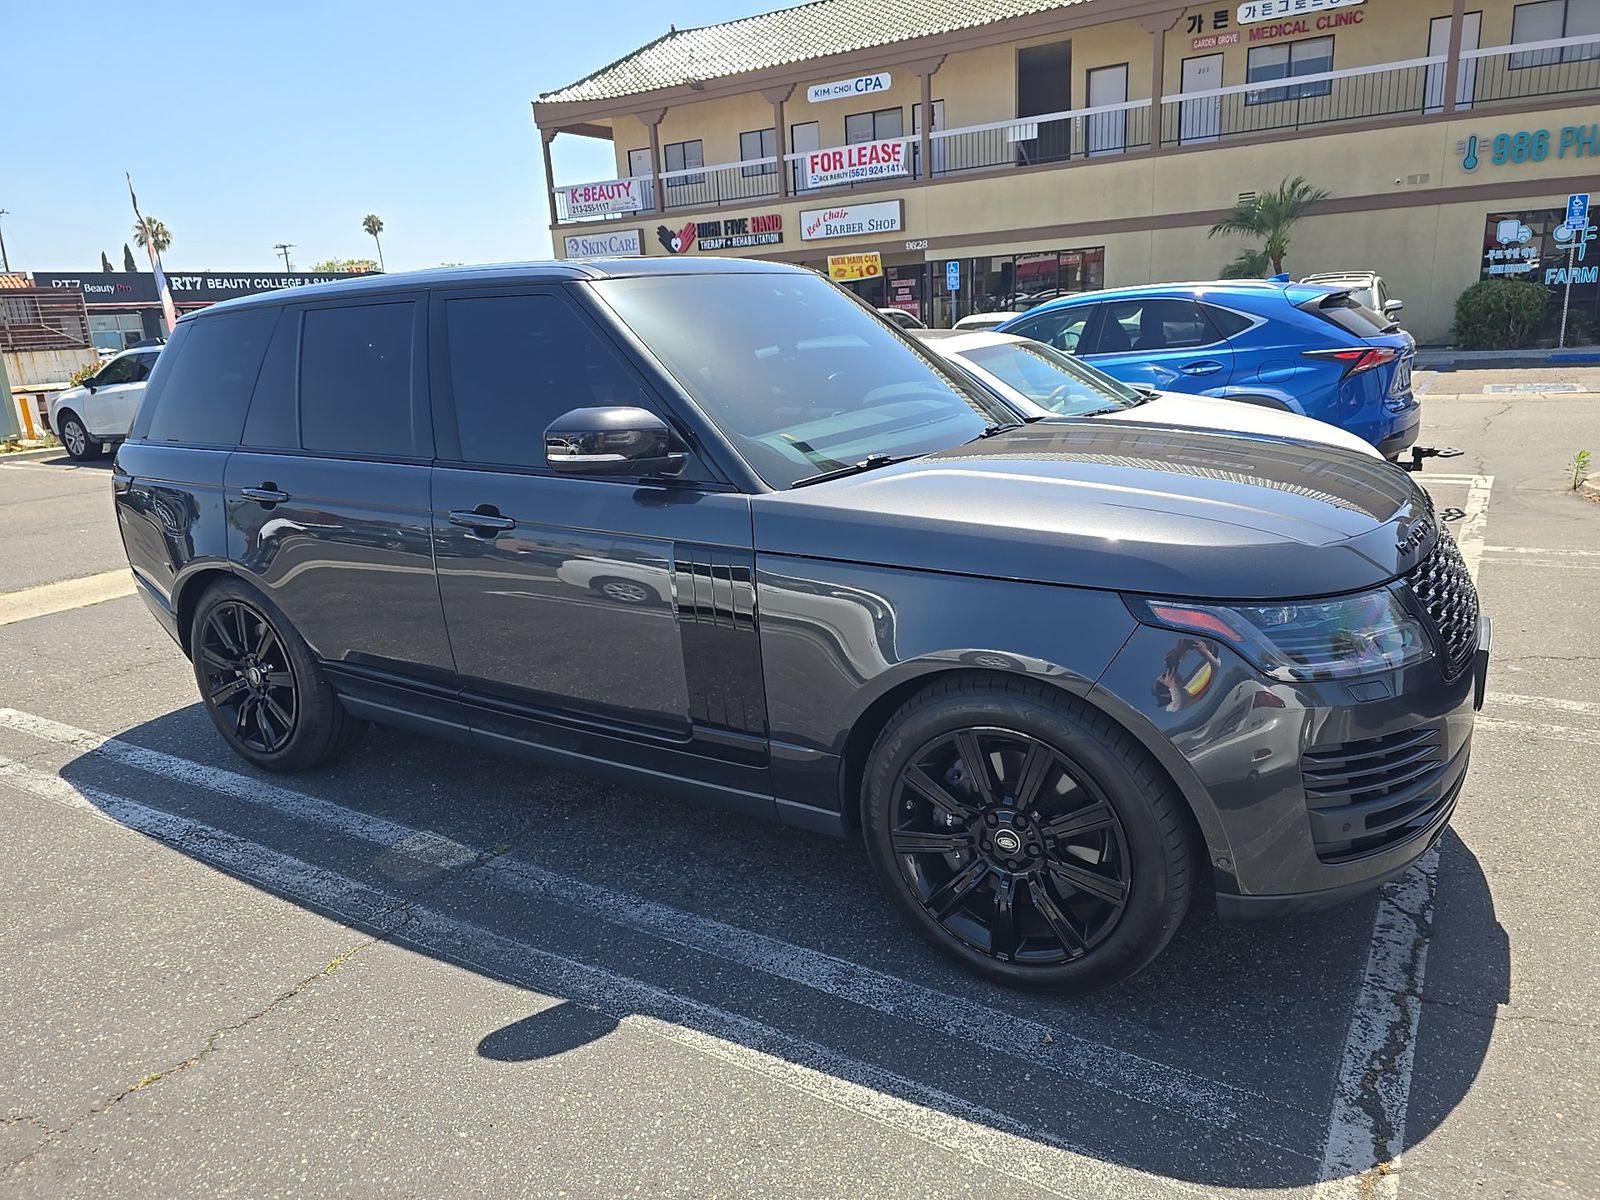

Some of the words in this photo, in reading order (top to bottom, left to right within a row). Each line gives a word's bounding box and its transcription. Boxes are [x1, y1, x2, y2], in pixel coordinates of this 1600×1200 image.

[1249, 20, 1311, 42] MEDICAL
[1193, 37, 1216, 49] GARDEN
[1218, 34, 1238, 45] GROVE
[814, 88, 830, 98] KIM
[833, 84, 852, 94] CHOI
[855, 76, 883, 93] CPA
[1492, 129, 1550, 166] 986
[1558, 124, 1600, 160] PH
[810, 151, 844, 174] FOR
[848, 143, 902, 168] LEASE
[849, 167, 868, 179] (562)
[571, 181, 631, 204] K-BEAUTY
[573, 202, 610, 214] 213-255-1117
[697, 221, 721, 238] HIGH
[724, 218, 748, 236] FIVE
[751, 214, 783, 233] HAND
[806, 218, 821, 237] Red
[823, 209, 848, 222] Chair
[825, 221, 864, 236] BARBER
[868, 218, 896, 231] SHOP
[581, 238, 607, 256] SKIN
[608, 235, 639, 253] CARE
[700, 238, 726, 250] THERAPY
[732, 233, 779, 247] REHABILITATION
[905, 240, 928, 250] 9828
[864, 254, 878, 263] CUT
[170, 276, 202, 290] RT7
[207, 278, 251, 289] BEAUTY
[253, 278, 301, 288] COLLEGE
[1545, 266, 1599, 285] FARM
[84, 283, 115, 295] Beauty
[117, 284, 132, 292] Pro
